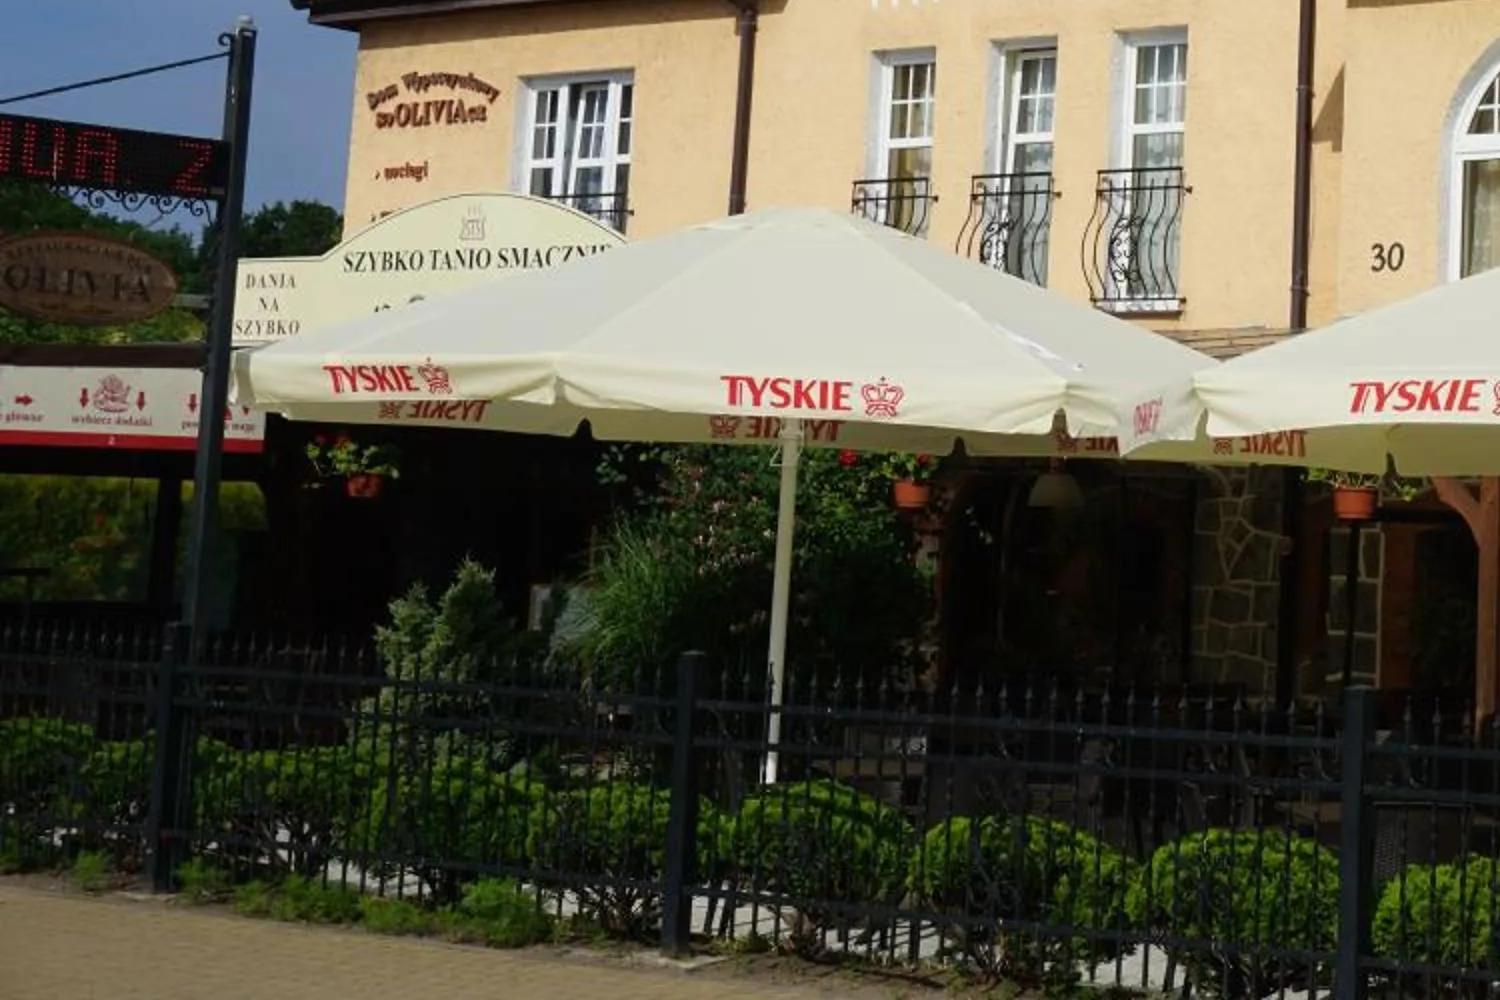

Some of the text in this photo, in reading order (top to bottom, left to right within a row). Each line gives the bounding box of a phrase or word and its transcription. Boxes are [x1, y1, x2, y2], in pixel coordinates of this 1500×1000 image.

[366, 83, 399, 111] Dom
[343, 250, 425, 273] SZYBKO
[429, 248, 492, 271] TANIO
[1371, 242, 1405, 272] 30
[245, 272, 297, 290] DANIA
[258, 296, 280, 313] NA
[235, 320, 301, 336] SZYBKO
[323, 365, 419, 393] TYSKIE
[720, 376, 853, 411] TYSKIE
[1349, 379, 1487, 413] TYSKIE
